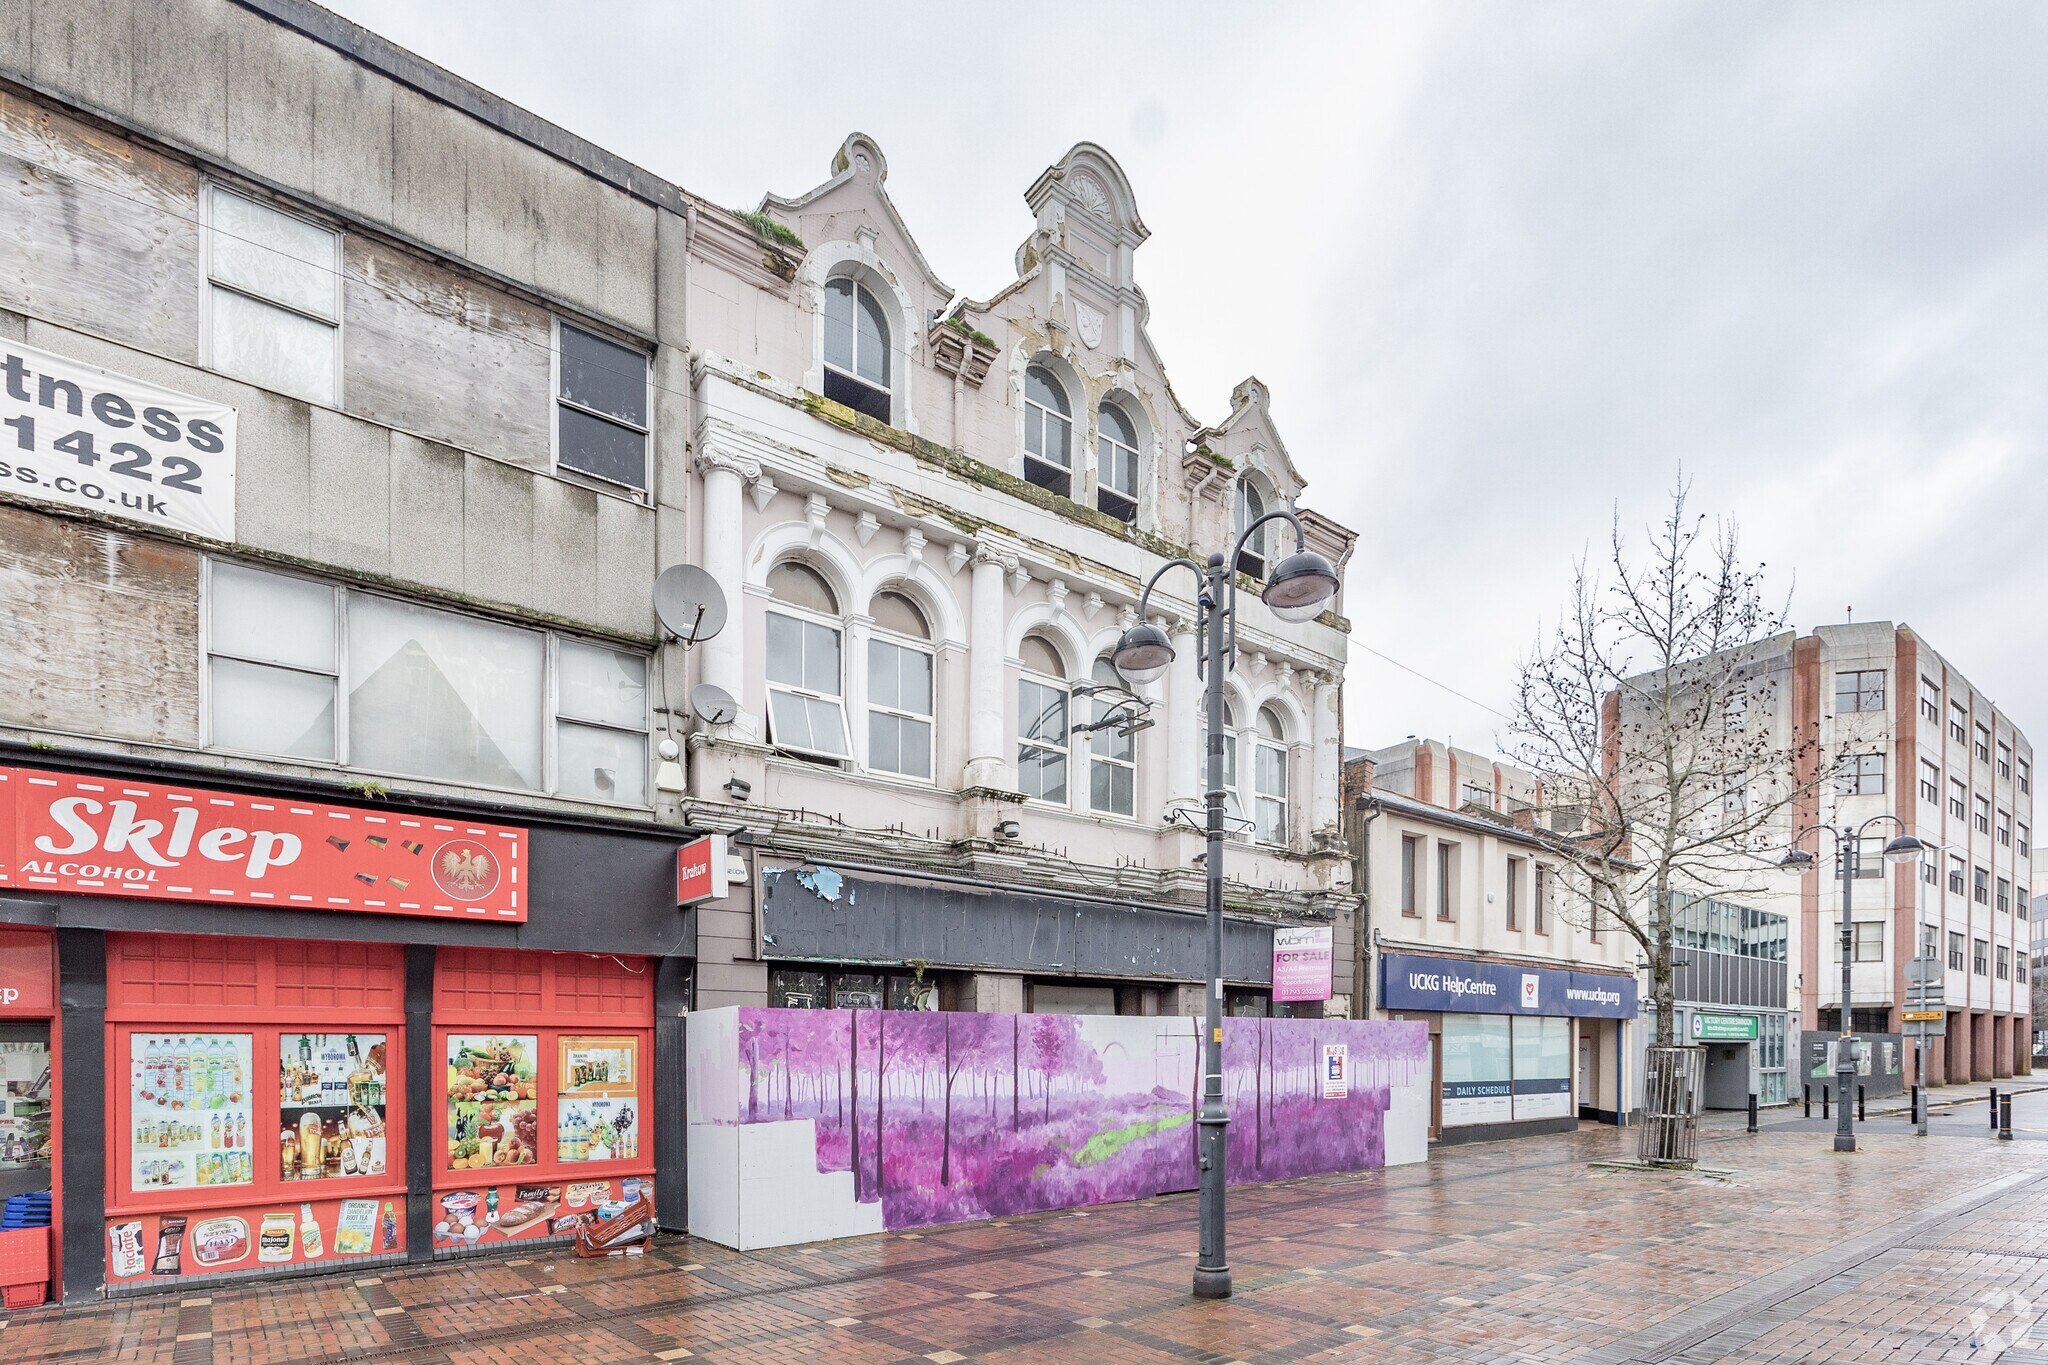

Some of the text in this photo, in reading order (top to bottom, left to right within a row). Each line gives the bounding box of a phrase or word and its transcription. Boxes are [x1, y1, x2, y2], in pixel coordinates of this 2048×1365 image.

[4, 414, 203, 495] 1422
[35, 796, 302, 879] Sklep
[20, 860, 159, 882] ALCOHOL
[682, 863, 707, 881] Krakow
[1276, 951, 1329, 962] FOR SALE
[1409, 972, 1497, 997] UCKG HelpCentre
[1566, 986, 1620, 1006] www.uckg.org
[1456, 1086, 1475, 1096] DAILY
[1477, 1085, 1511, 1095] SCHEDULE
[519, 1186, 550, 1199] Family's
[346, 1208, 373, 1216] DANDELION
[208, 1237, 235, 1248] HAM
